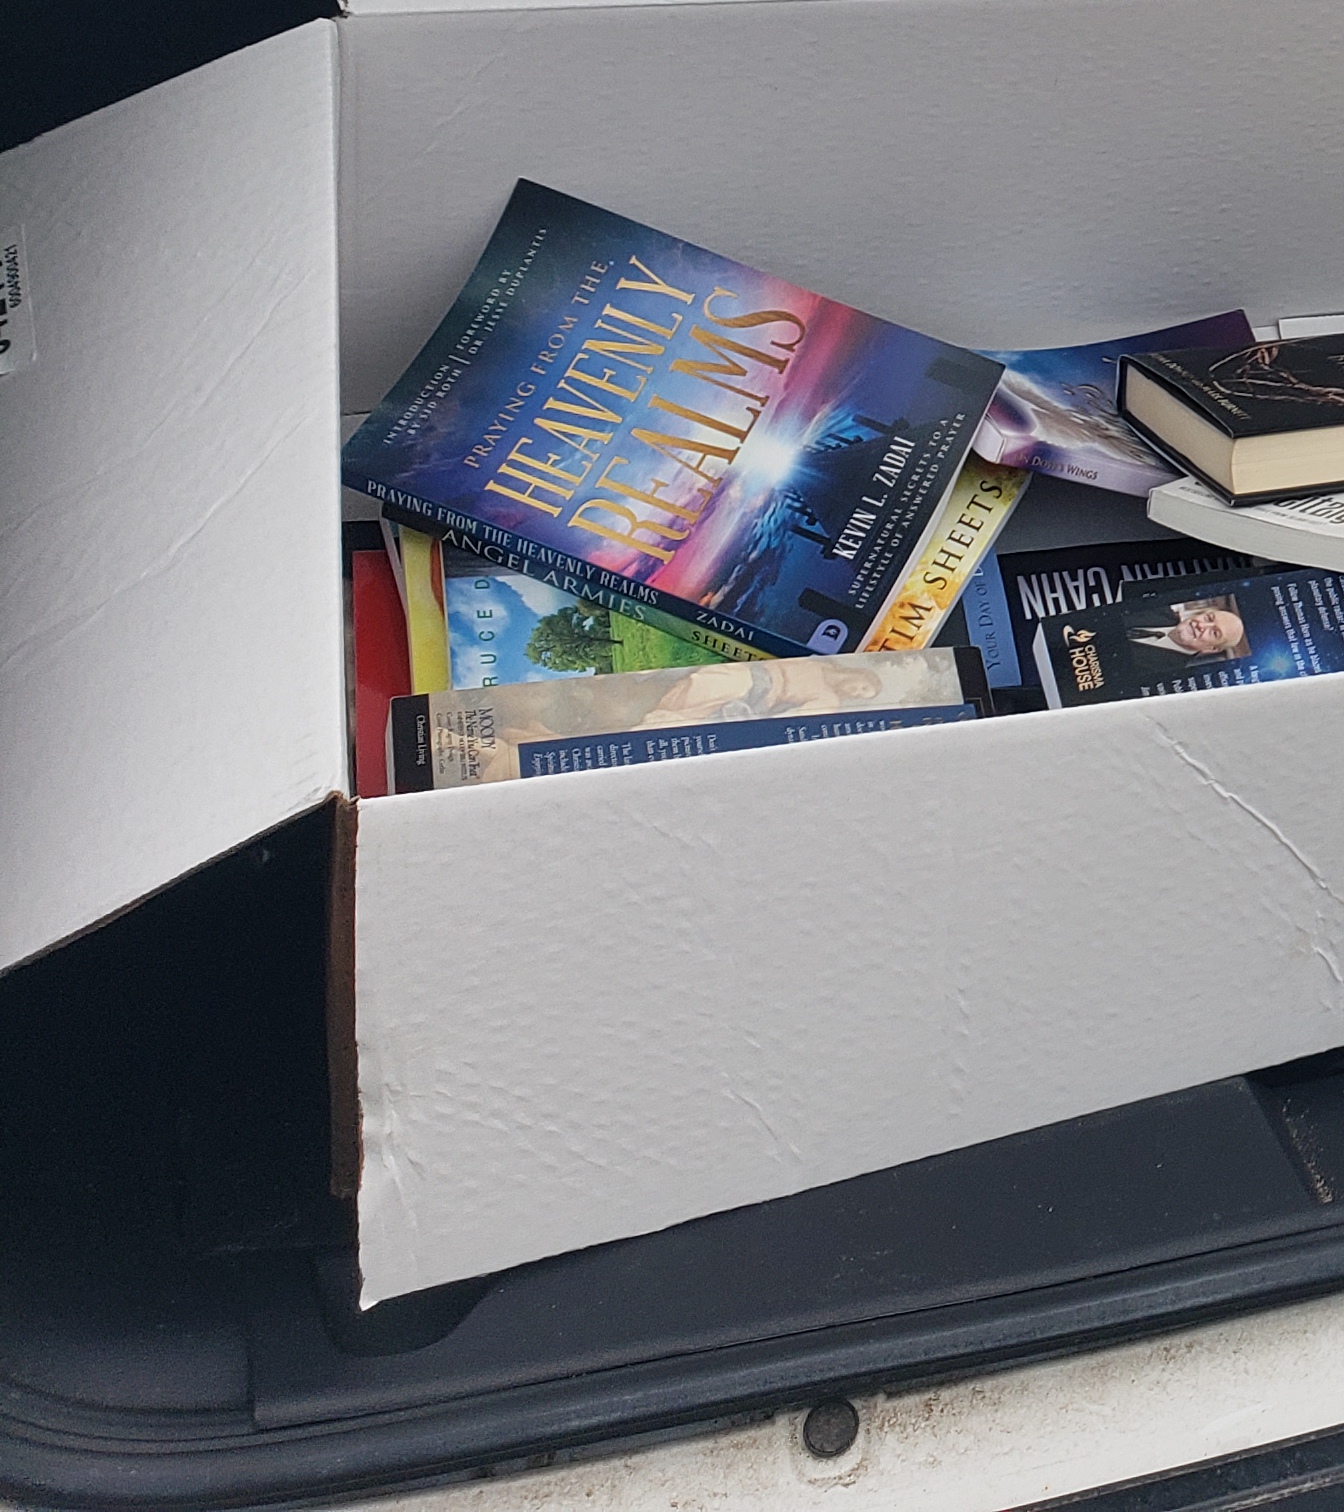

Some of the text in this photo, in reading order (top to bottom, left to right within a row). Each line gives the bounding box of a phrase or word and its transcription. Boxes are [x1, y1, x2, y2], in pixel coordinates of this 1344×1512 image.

[506, 228, 547, 296] DUPLANTIS
[456, 269, 511, 351] FOREWORD BY
[463, 260, 608, 469] PRAYING FROM THE
[484, 255, 696, 518] HEAVENLY
[383, 363, 450, 447] INTRODUCTION
[407, 421, 422, 436] BY
[437, 369, 462, 400] ROTH
[566, 286, 806, 565] REALMS
[831, 435, 916, 560] KEVIN L. ZADAI
[849, 418, 948, 596] SUPERNATURAL SECRETS TO A
[1066, 464, 1099, 480] WINGS
[855, 412, 966, 609] LIFESTYLE OF ANSWERED PRAYER
[366, 479, 755, 641] PRAYING FROM THE HEAVENLY REALMS ZADAI
[440, 528, 536, 577] ANGEL
[543, 568, 648, 621] ARMIES
[880, 478, 1003, 652] TIM SHEETS
[1016, 567, 1113, 620] CAHN
[978, 601, 994, 627] DAY
[986, 631, 1001, 670] YOUR
[1069, 647, 1093, 691] HOUSE
[1084, 643, 1105, 688] CHARISMA
[414, 714, 428, 765] Christian Living
[464, 710, 475, 720] The
[478, 708, 496, 750] MOODY
